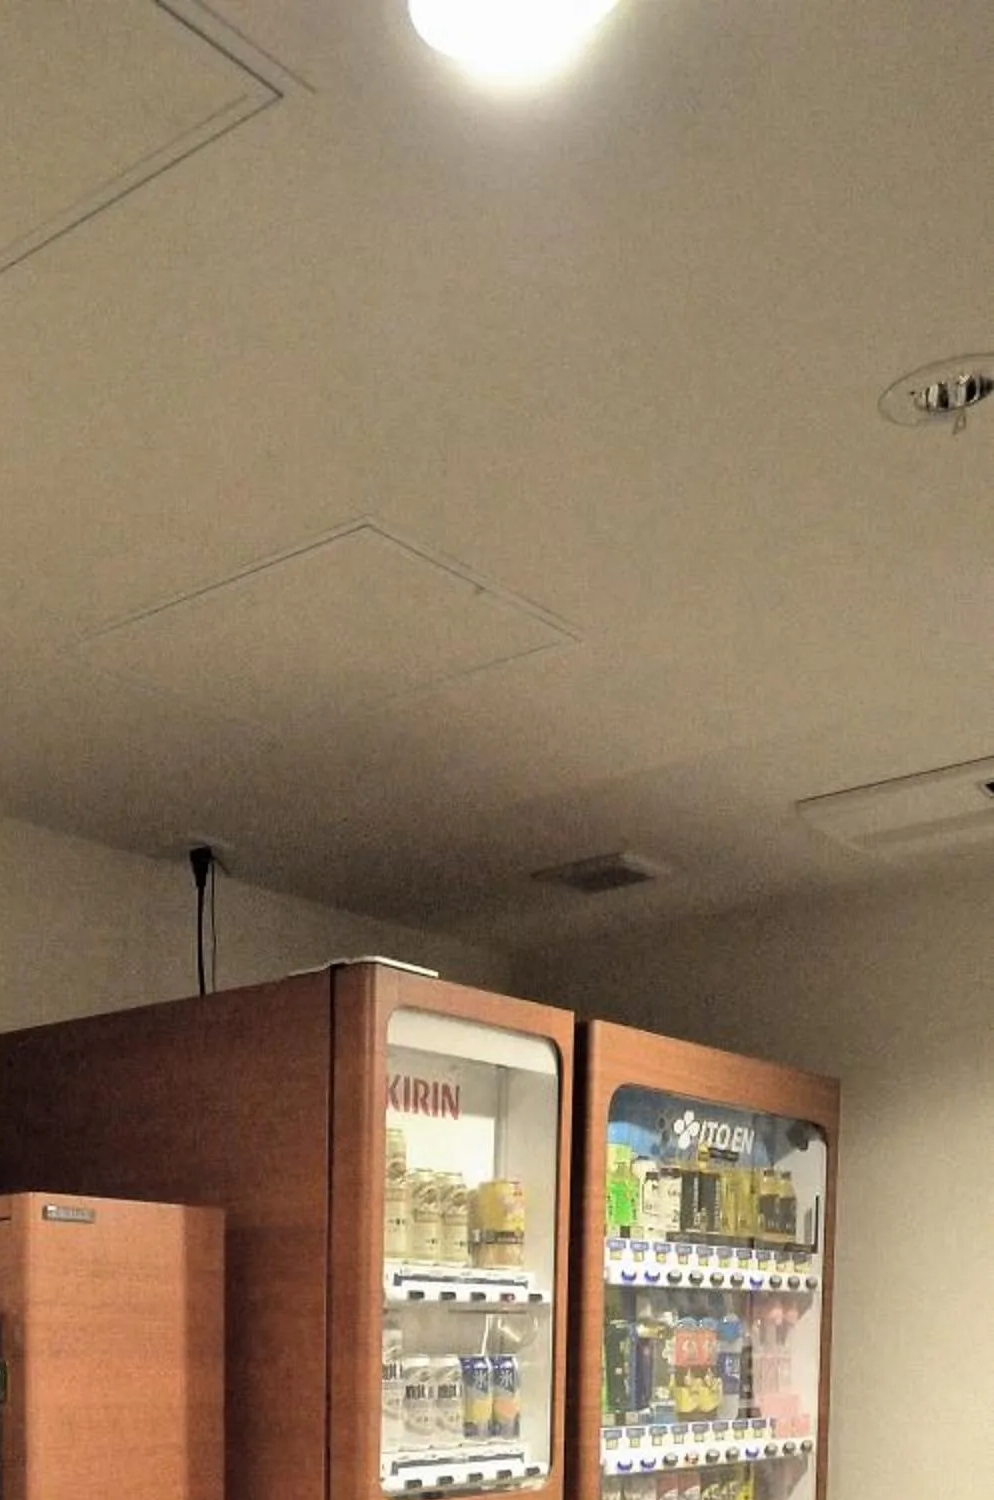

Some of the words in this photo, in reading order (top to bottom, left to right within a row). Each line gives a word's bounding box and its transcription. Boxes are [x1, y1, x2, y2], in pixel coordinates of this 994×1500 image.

[386, 1073, 461, 1120] KIRIN
[699, 1120, 730, 1151] ITO
[731, 1126, 755, 1155] EN
